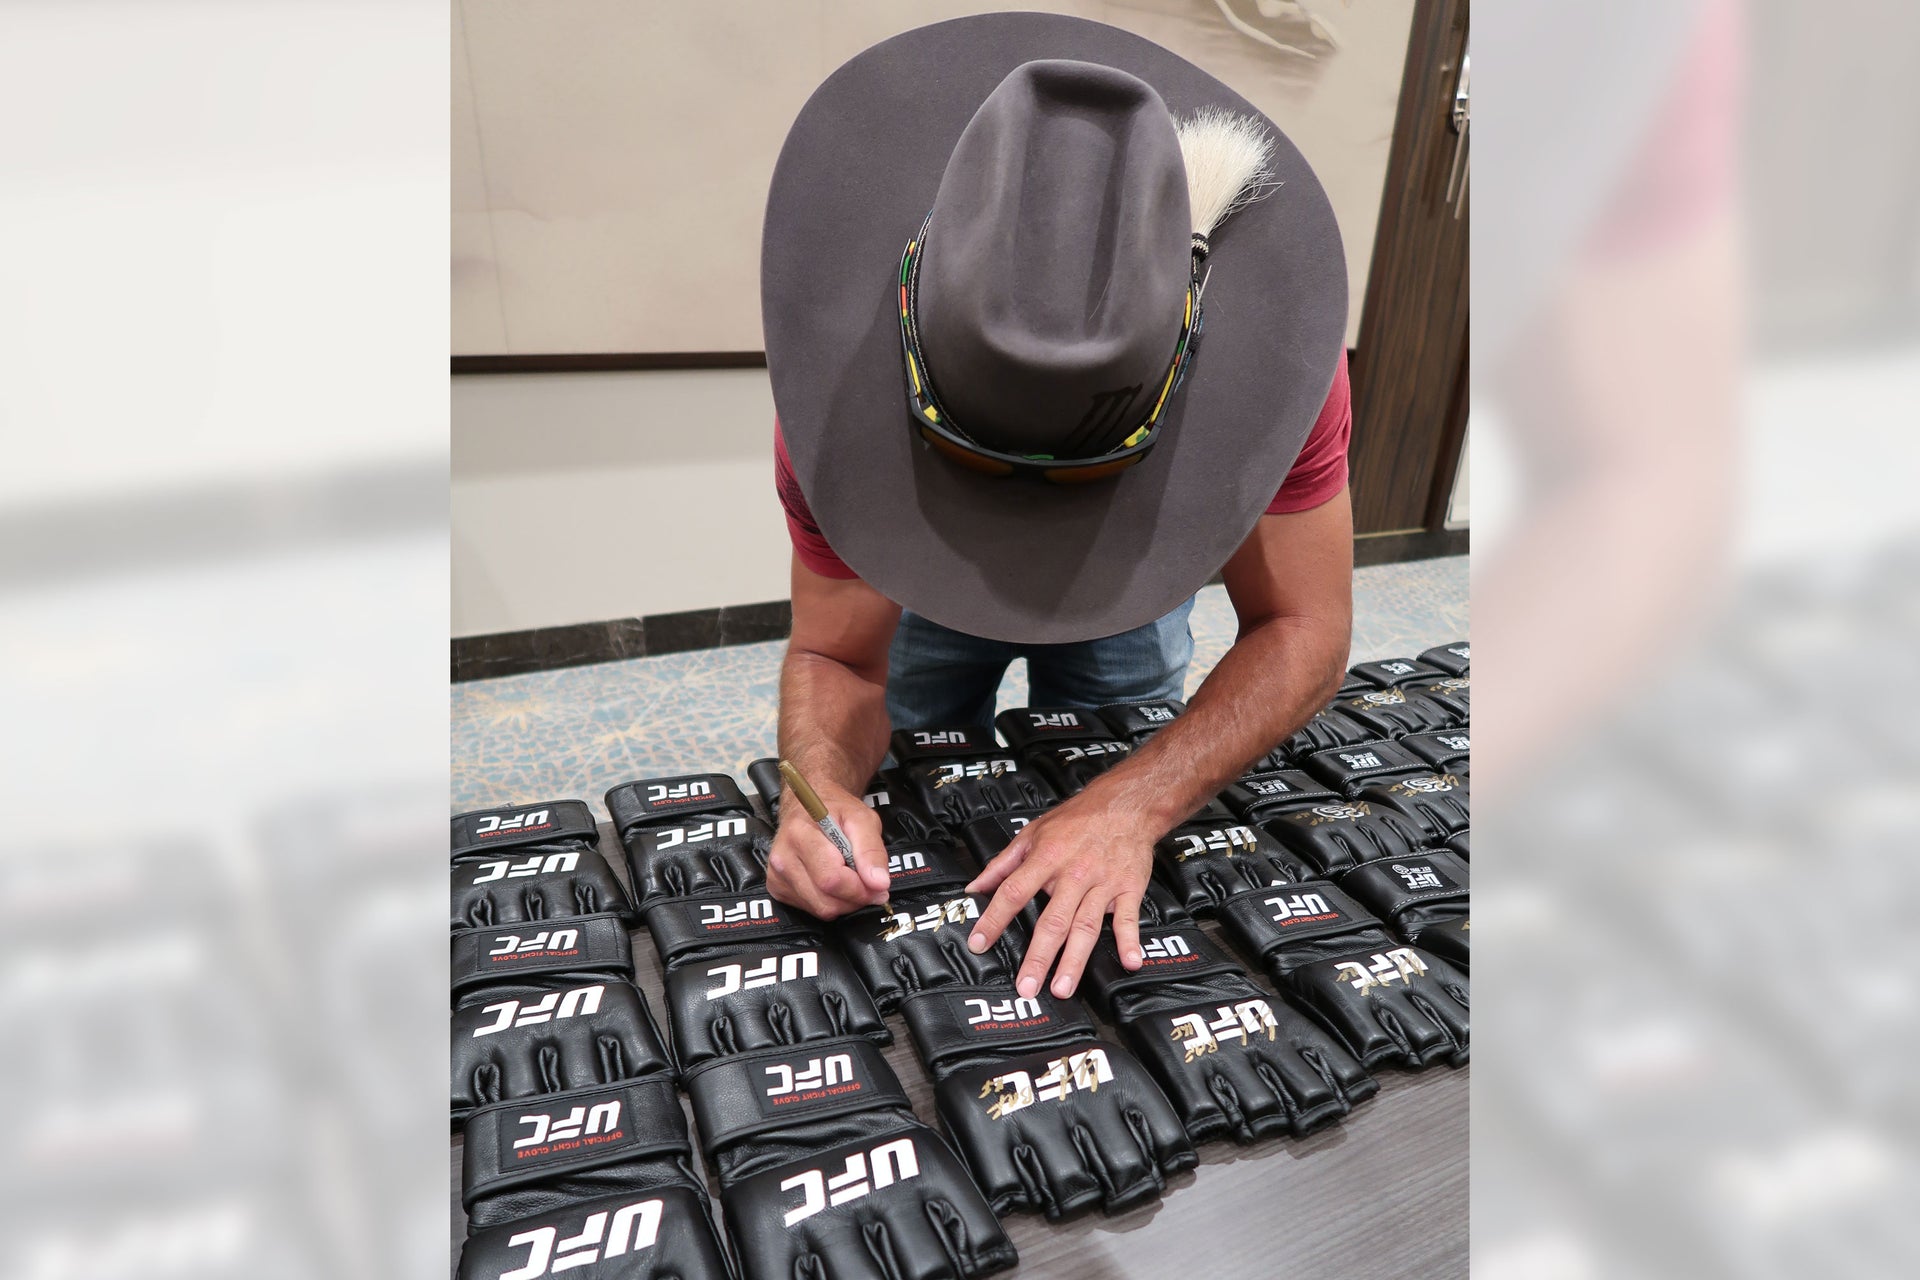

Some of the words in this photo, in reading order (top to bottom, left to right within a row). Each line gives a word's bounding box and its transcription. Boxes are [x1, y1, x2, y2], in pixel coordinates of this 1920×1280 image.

[1029, 713, 1079, 727] UFC
[914, 731, 966, 745] UFC
[1058, 741, 1129, 761] UFC
[1346, 757, 1381, 768] UFC
[939, 760, 1017, 782] UFC
[648, 781, 710, 802] UFC
[477, 810, 549, 834] UFC
[656, 818, 746, 850] UFC
[1174, 826, 1257, 856] UFC
[473, 852, 580, 885] UFC
[888, 852, 926, 874] UF
[1401, 873, 1441, 886] UFC
[701, 899, 773, 924] UFC
[880, 898, 979, 942] UFC
[1264, 893, 1331, 922] UFC
[489, 929, 578, 956] UFC
[520, 951, 544, 959] FIGHT
[707, 952, 818, 1001] UFC
[1334, 947, 1429, 990] UFC
[473, 986, 605, 1037] UFC
[965, 997, 1042, 1025] UFC
[1171, 999, 1278, 1050] UFC
[766, 1054, 853, 1096] UFC
[993, 1049, 1114, 1116] UFC
[773, 1095, 800, 1105] GLOVE
[802, 1090, 826, 1101] FIGHT
[827, 1082, 861, 1095] OFFICIAL
[513, 1100, 621, 1149] UFC
[552, 1140, 580, 1152] FIGHT
[583, 1131, 623, 1145] OFFICIAL
[517, 1147, 550, 1159] GLOVE
[781, 1138, 919, 1228] UFC
[499, 1200, 663, 1280] UFC
